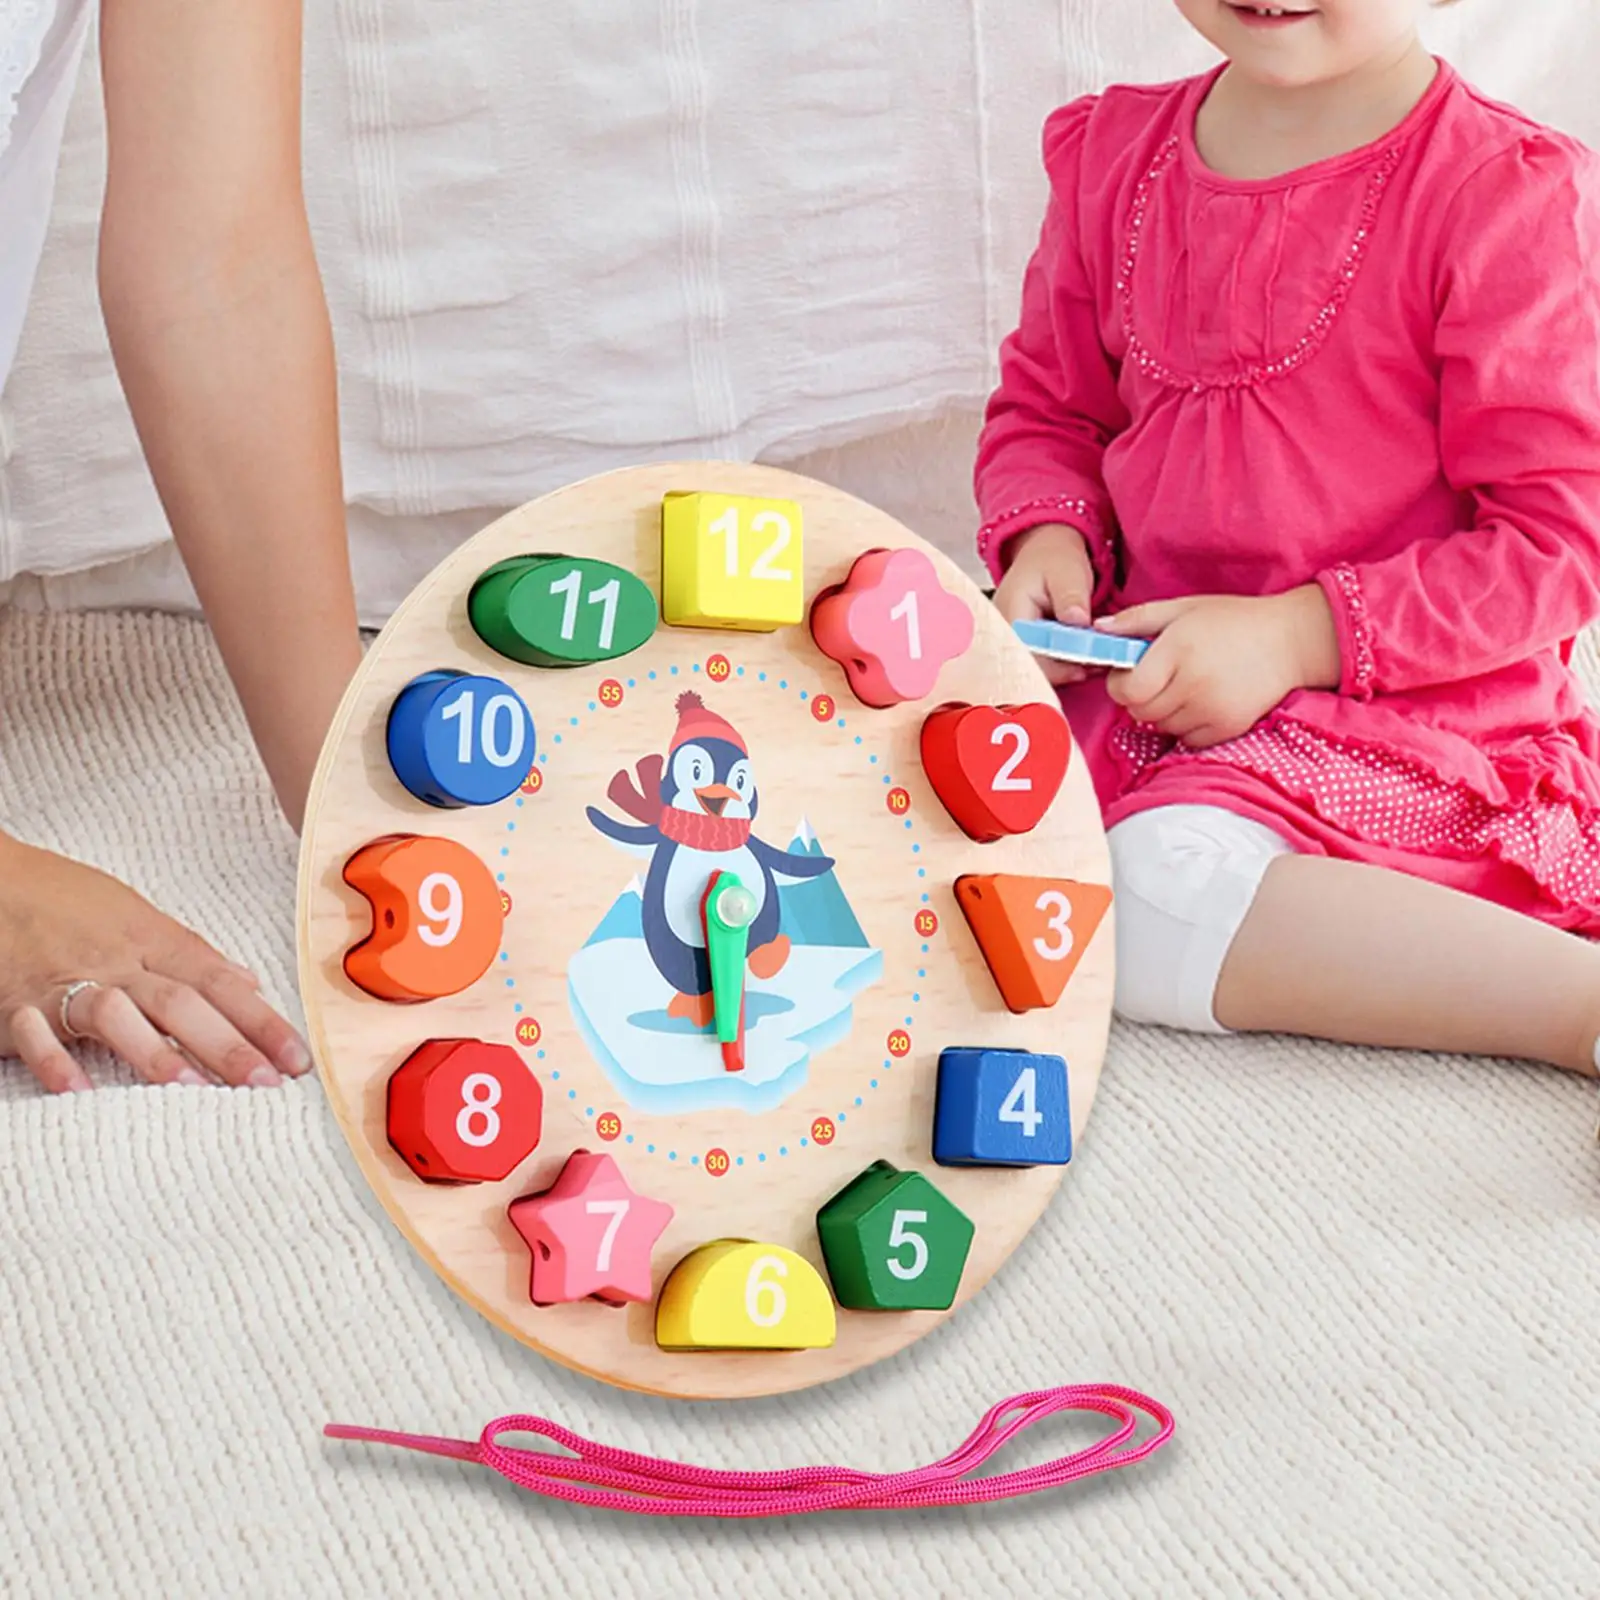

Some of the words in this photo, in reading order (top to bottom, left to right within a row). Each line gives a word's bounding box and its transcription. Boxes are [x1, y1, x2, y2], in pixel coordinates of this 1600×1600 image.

[709, 507, 793, 581] 12
[550, 570, 620, 649] 11
[891, 591, 921, 659] 1
[602, 685, 621, 702] 55
[708, 660, 728, 676] 60
[443, 691, 526, 767] 10
[818, 701, 828, 716] 5
[991, 723, 1031, 790] 2
[891, 794, 906, 809] 10
[418, 873, 462, 946] 9
[919, 916, 933, 931] 15
[1034, 891, 1073, 960] 3
[519, 1024, 539, 1040] 40
[890, 1036, 909, 1051] 20
[456, 1073, 501, 1146] 8
[599, 1119, 619, 1135] 35
[814, 1123, 833, 1139] 25
[999, 1068, 1042, 1136] 4
[708, 1154, 727, 1170] 30
[587, 1200, 629, 1271] 7
[887, 1210, 927, 1279] 5
[745, 1256, 788, 1326] 6
